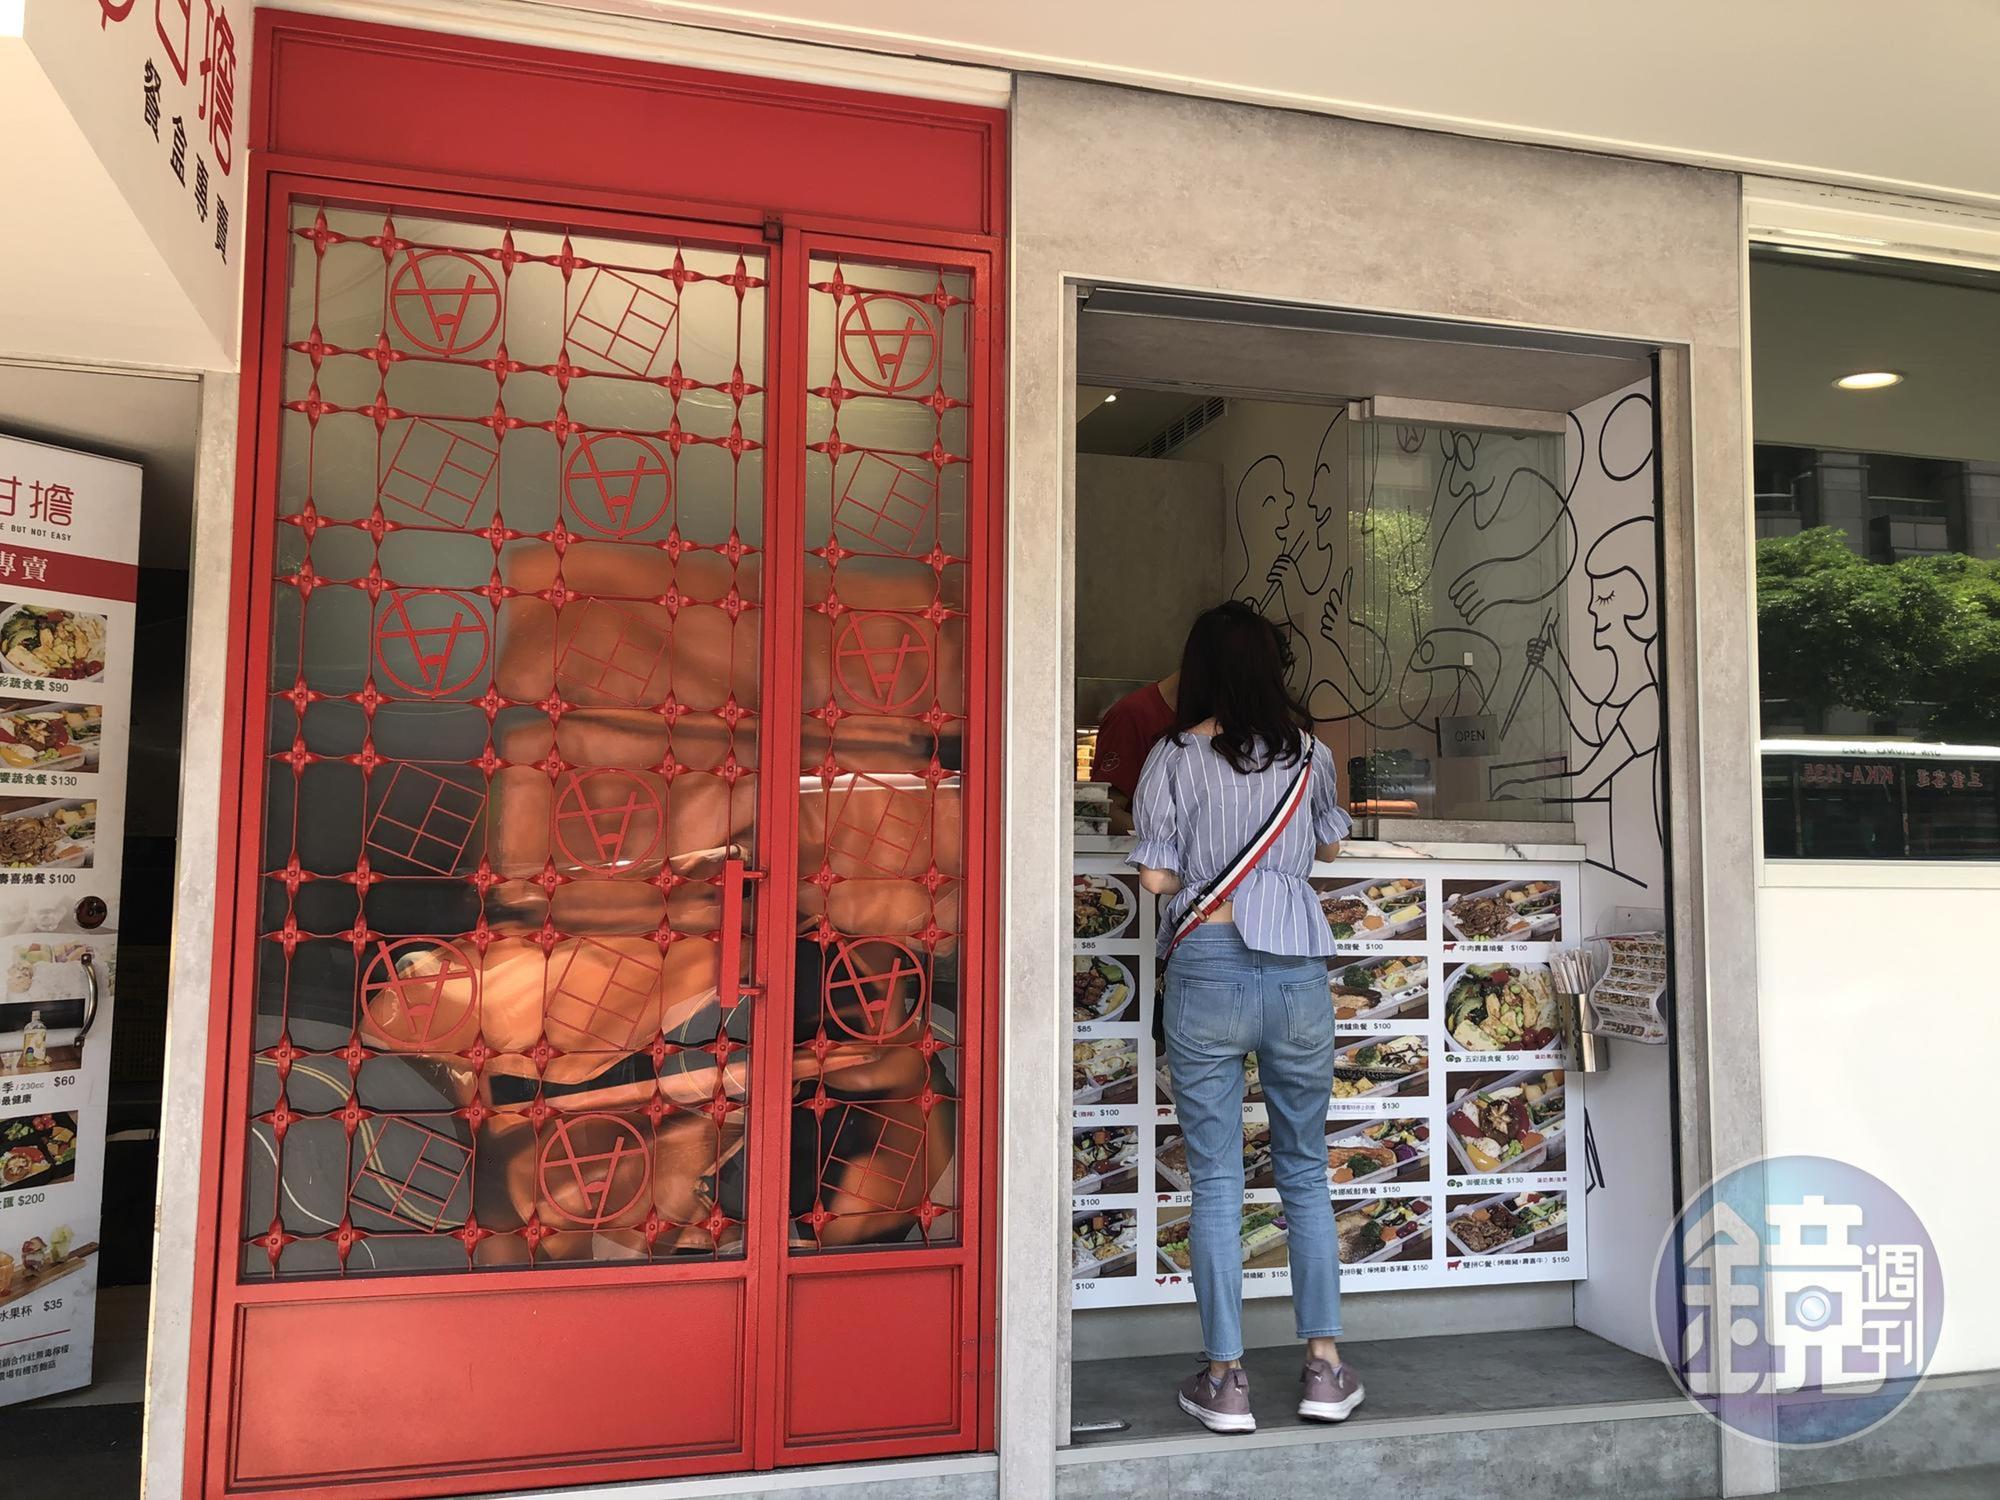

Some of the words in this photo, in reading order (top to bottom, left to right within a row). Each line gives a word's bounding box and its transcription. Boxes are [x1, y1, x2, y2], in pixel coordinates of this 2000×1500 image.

[144, 57, 229, 265] 餐盒專賣
[11, 524, 26, 534] BUT
[31, 528, 46, 538] NOT
[51, 531, 72, 541] EASY
[49, 682, 69, 693] $90
[1455, 730, 1485, 743] OPEN
[51, 776, 77, 786] $130
[49, 873, 76, 884] $100
[54, 1075, 75, 1087] $60
[1382, 1102, 1400, 1110] $130
[18, 1192, 45, 1206] $200
[1075, 1282, 1095, 1290] $100
[43, 1299, 63, 1312] $35
